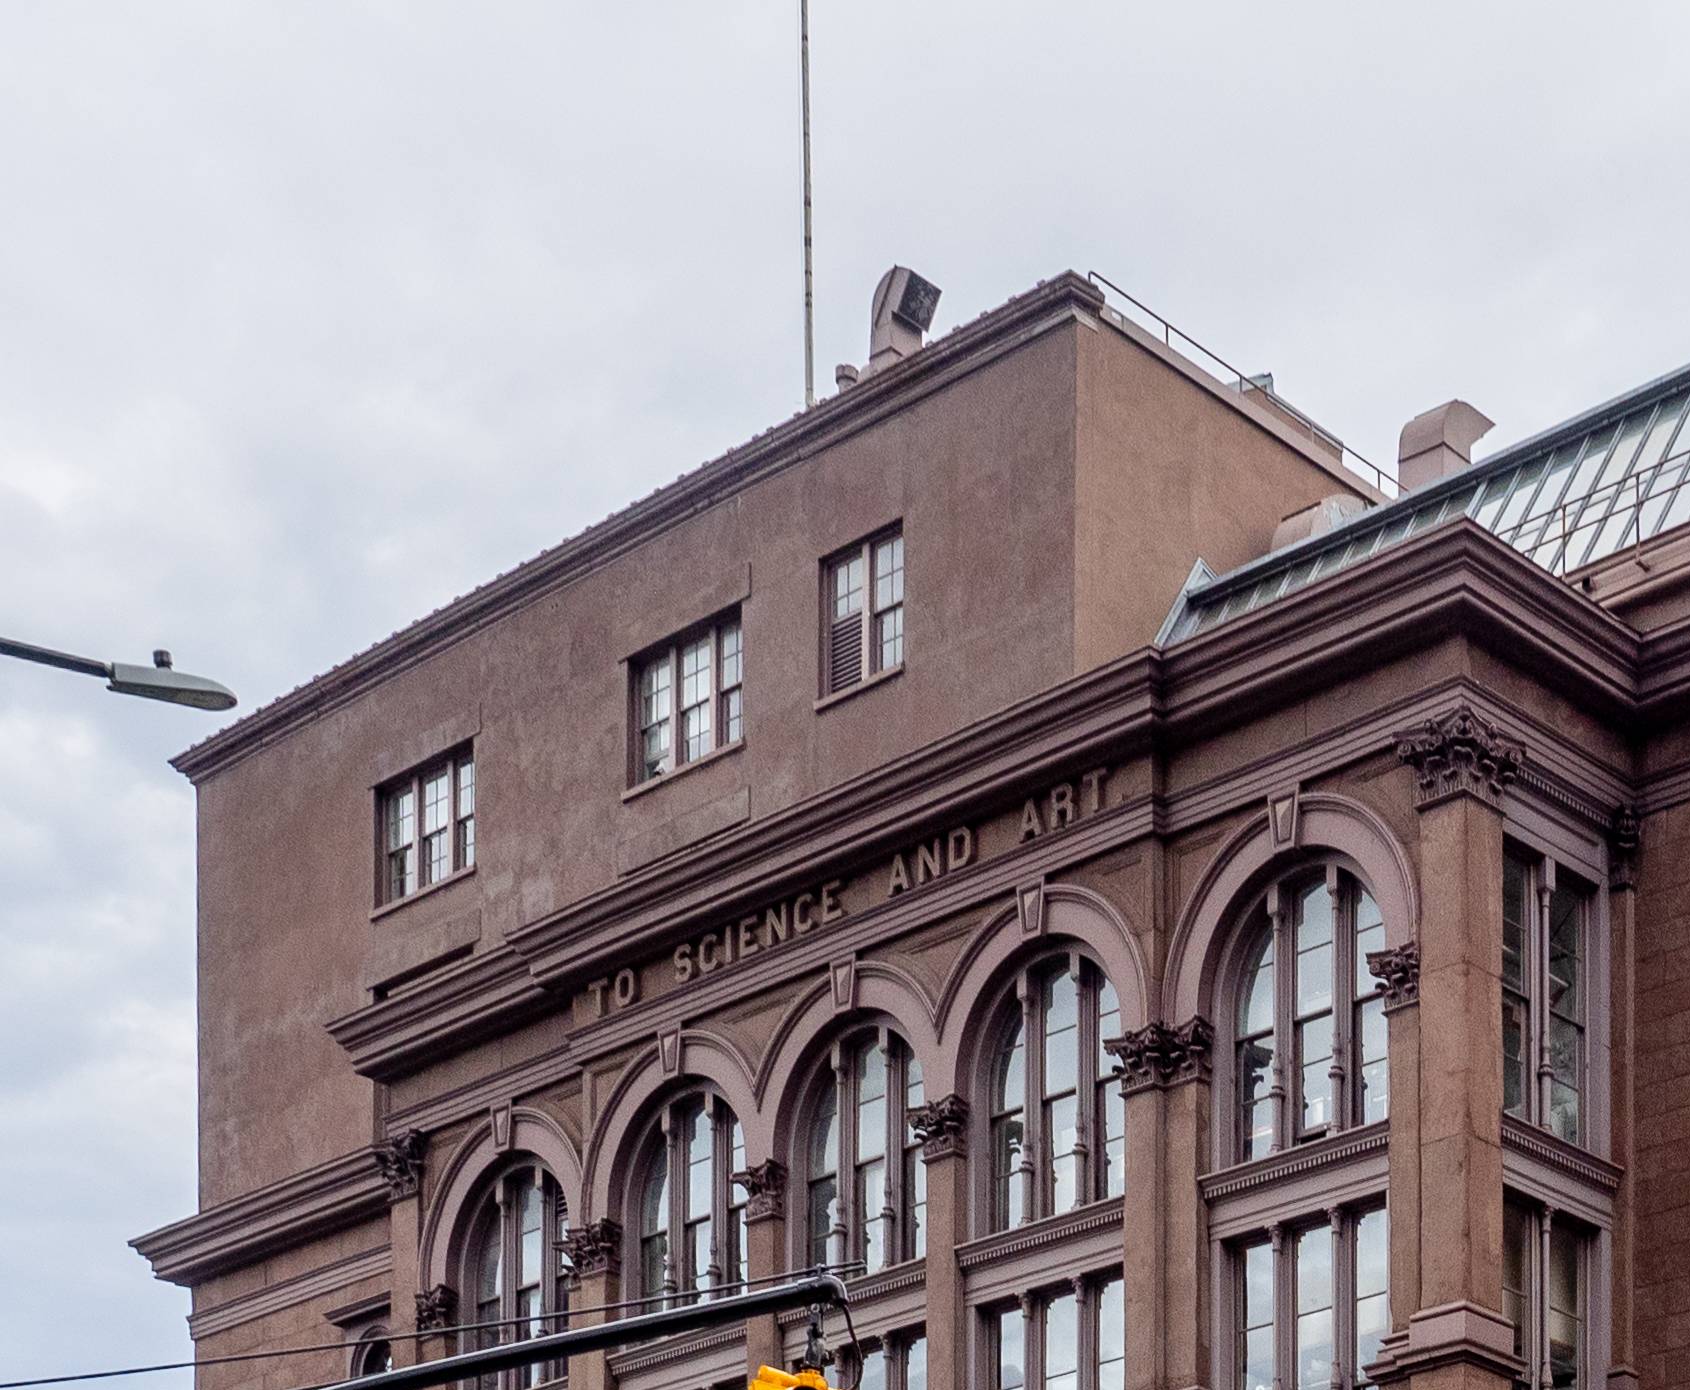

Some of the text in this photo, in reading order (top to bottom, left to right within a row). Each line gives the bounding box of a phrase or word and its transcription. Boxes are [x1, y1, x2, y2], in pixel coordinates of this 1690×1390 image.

[588, 967, 636, 1017] TO
[673, 880, 843, 983] SCIENCE
[887, 826, 972, 898] AND
